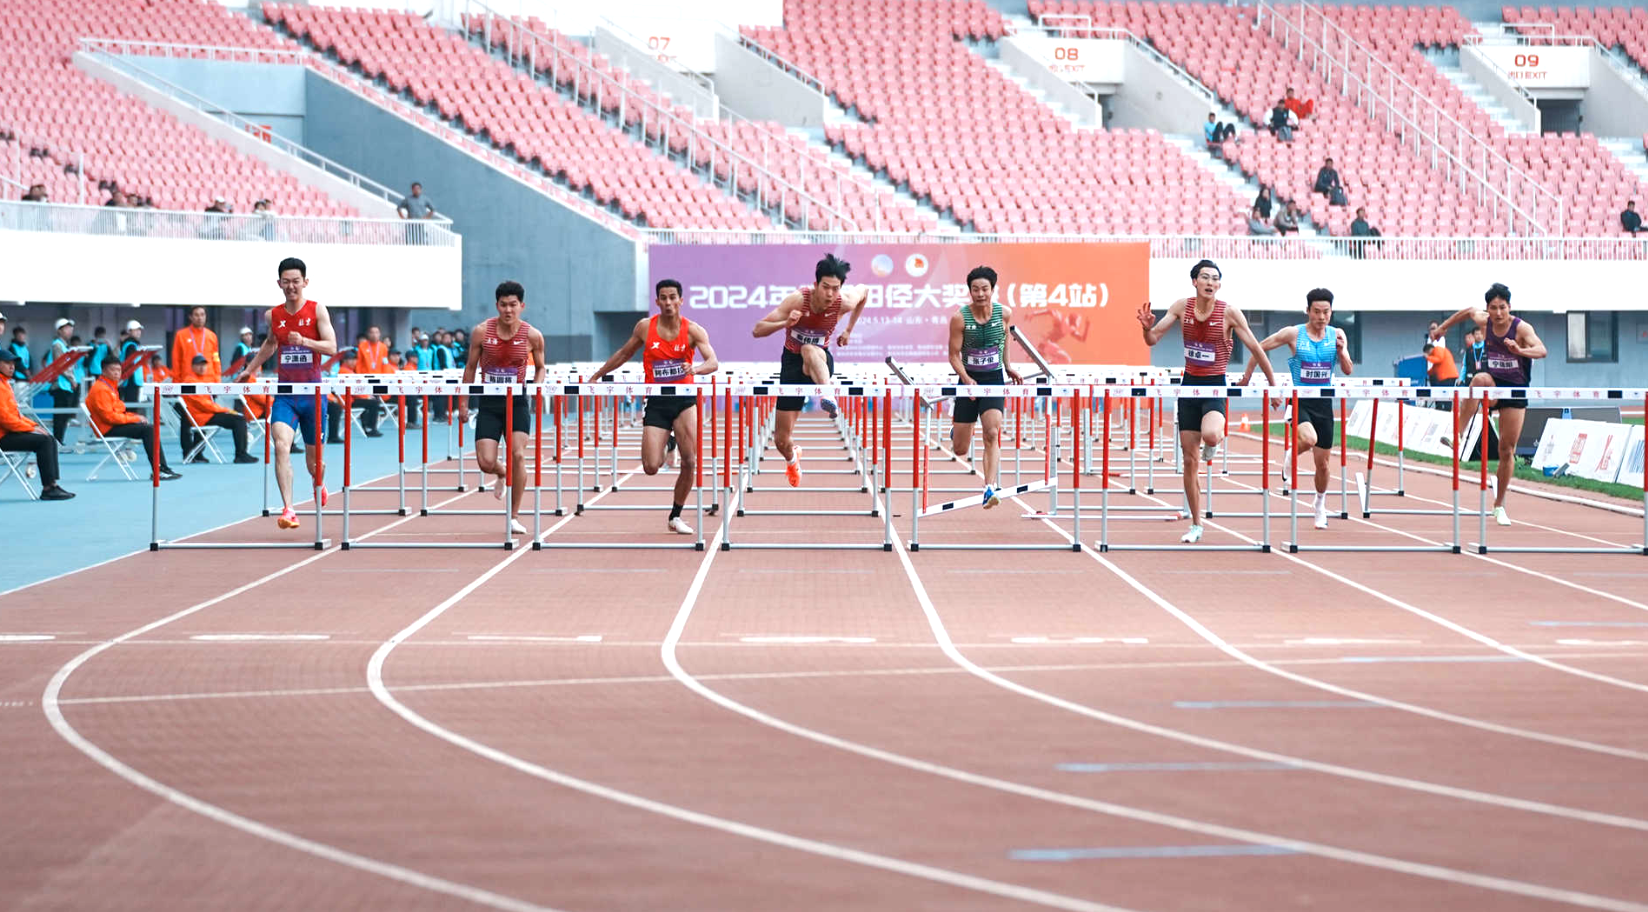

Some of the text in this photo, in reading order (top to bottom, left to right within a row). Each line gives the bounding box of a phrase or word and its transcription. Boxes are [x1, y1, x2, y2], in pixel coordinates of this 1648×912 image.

[648, 36, 671, 51] 07
[1055, 47, 1079, 60] 08
[1514, 54, 1539, 67] 09
